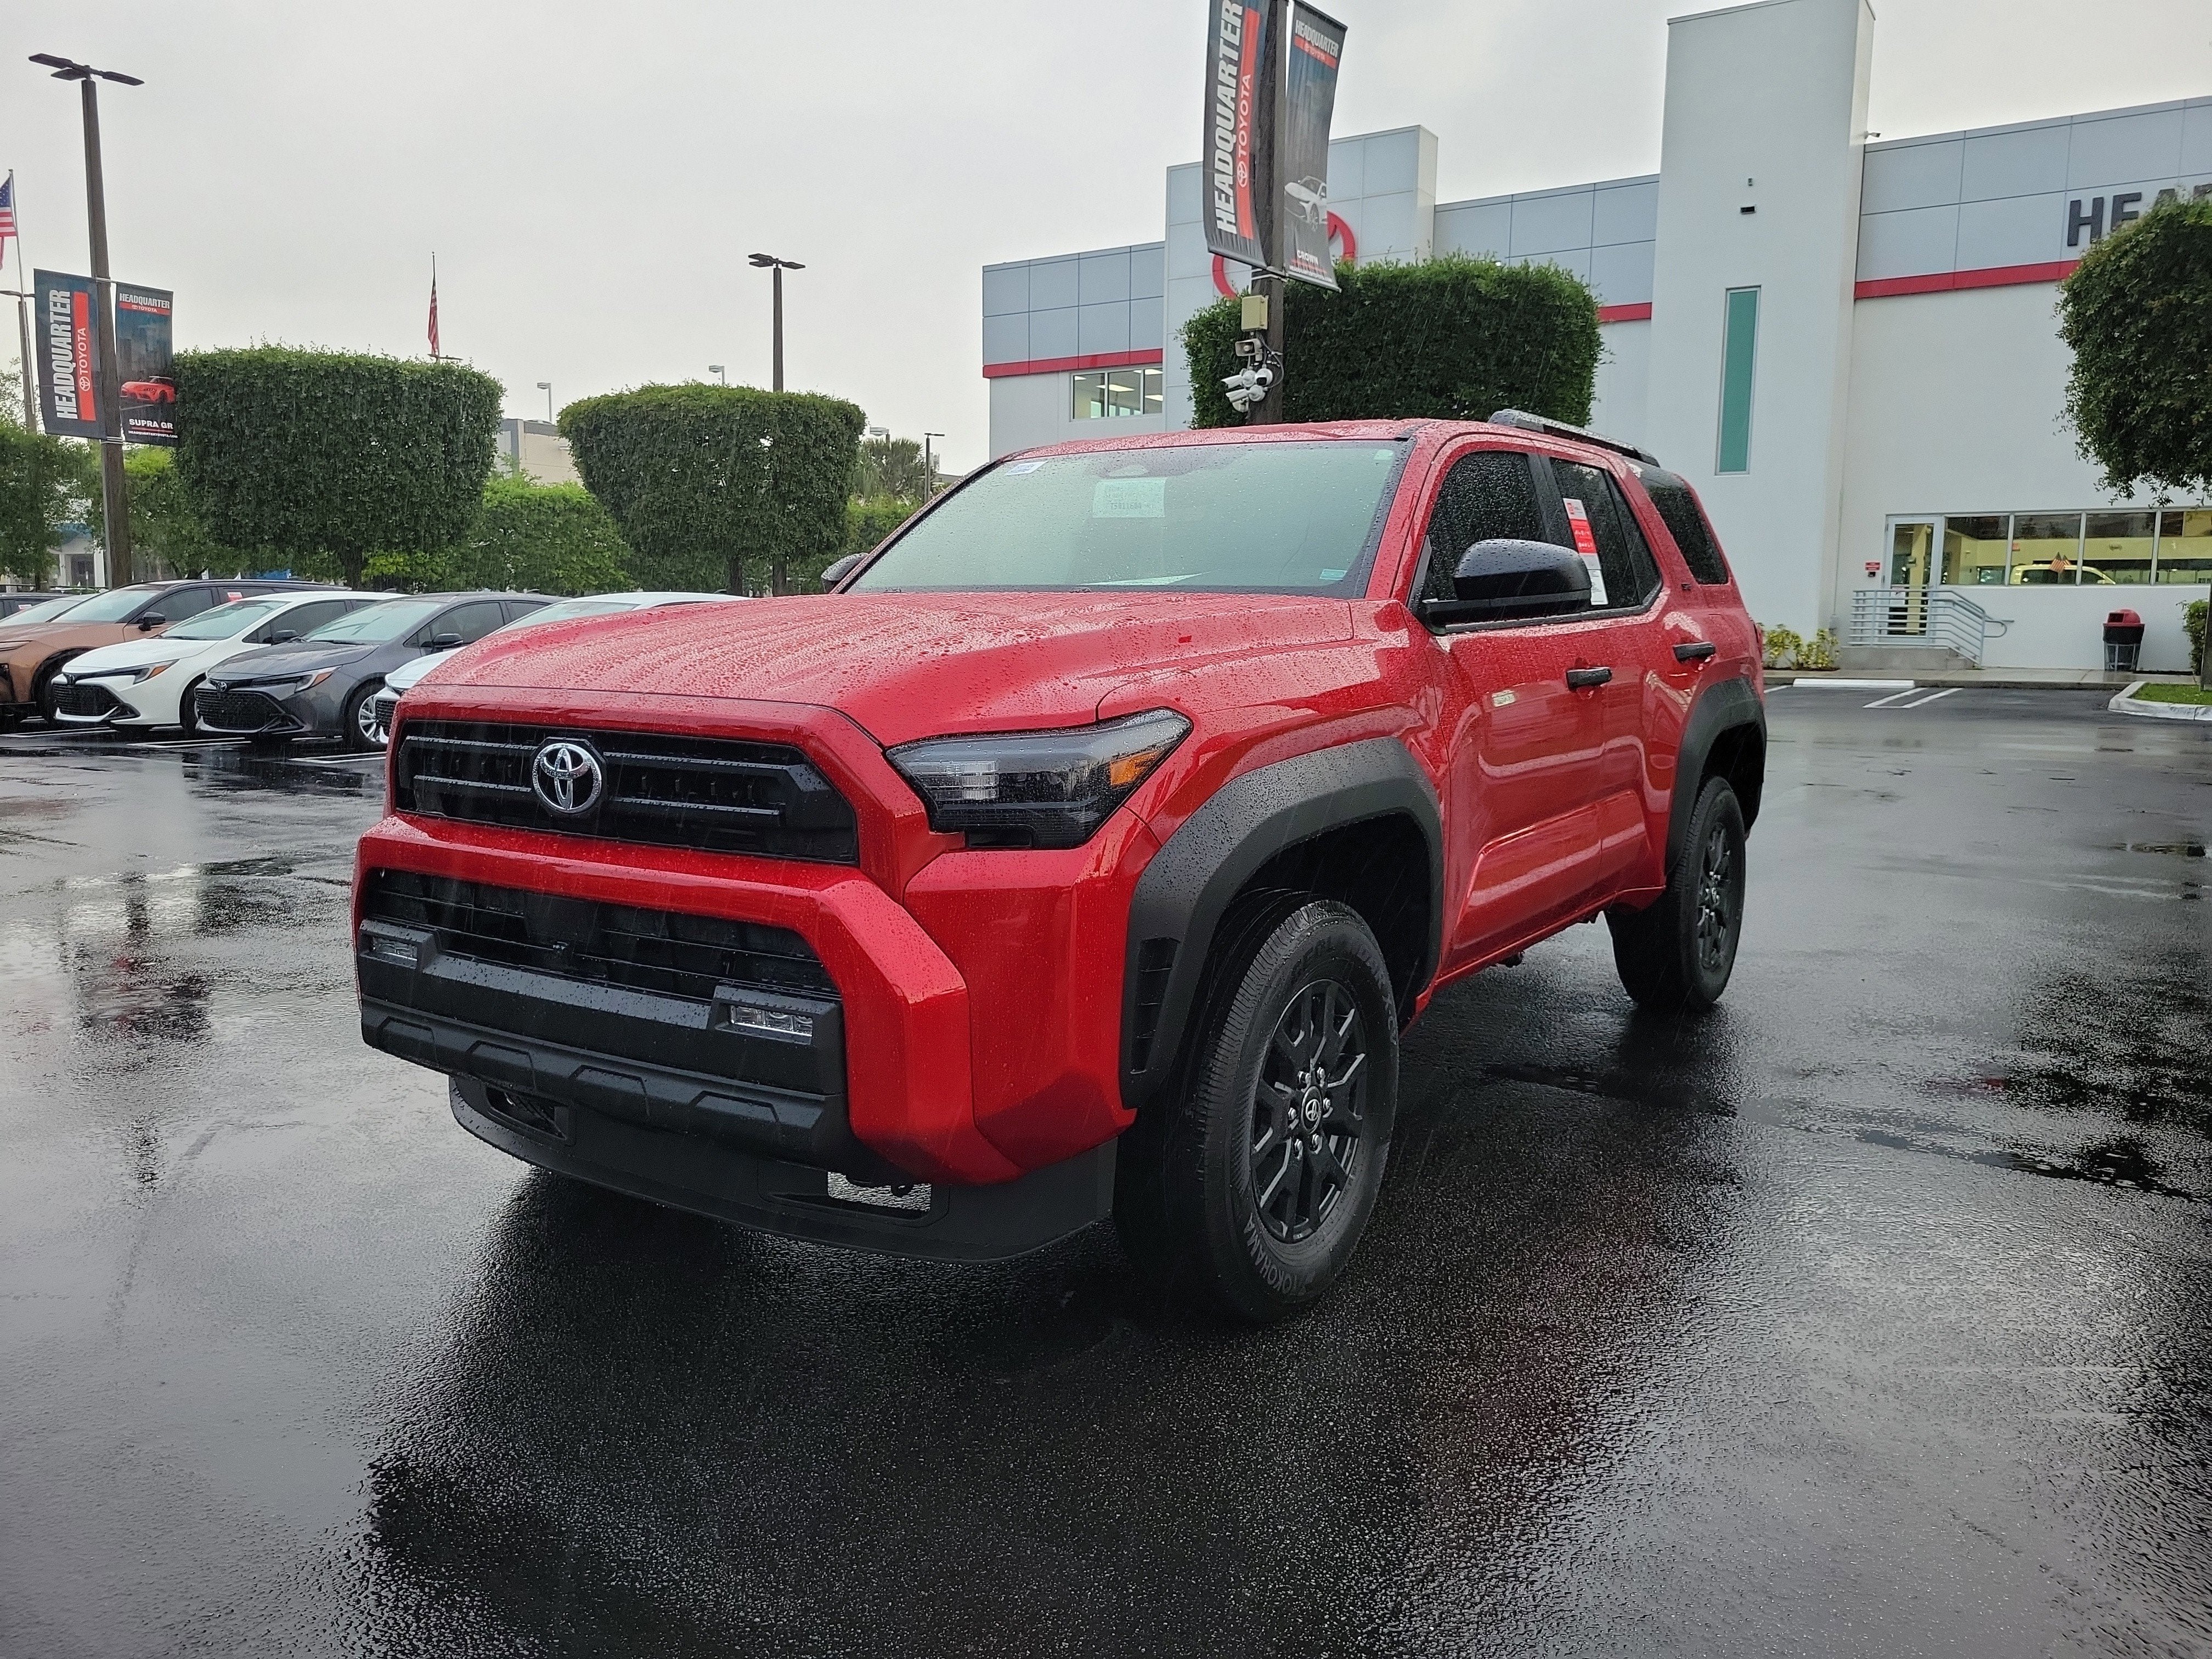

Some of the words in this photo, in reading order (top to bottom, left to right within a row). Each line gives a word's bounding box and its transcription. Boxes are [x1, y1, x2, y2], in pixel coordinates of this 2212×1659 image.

[1295, 19, 1339, 58] HEADQUARTER
[1214, 0, 1243, 235] HEADQUARTER
[1238, 75, 1251, 157] TOYOTA
[119, 292, 170, 309] HEADQUARTER
[49, 290, 78, 420] HEADQUARTER
[77, 328, 88, 375] TOYOTA
[129, 419, 159, 428] SUPRA
